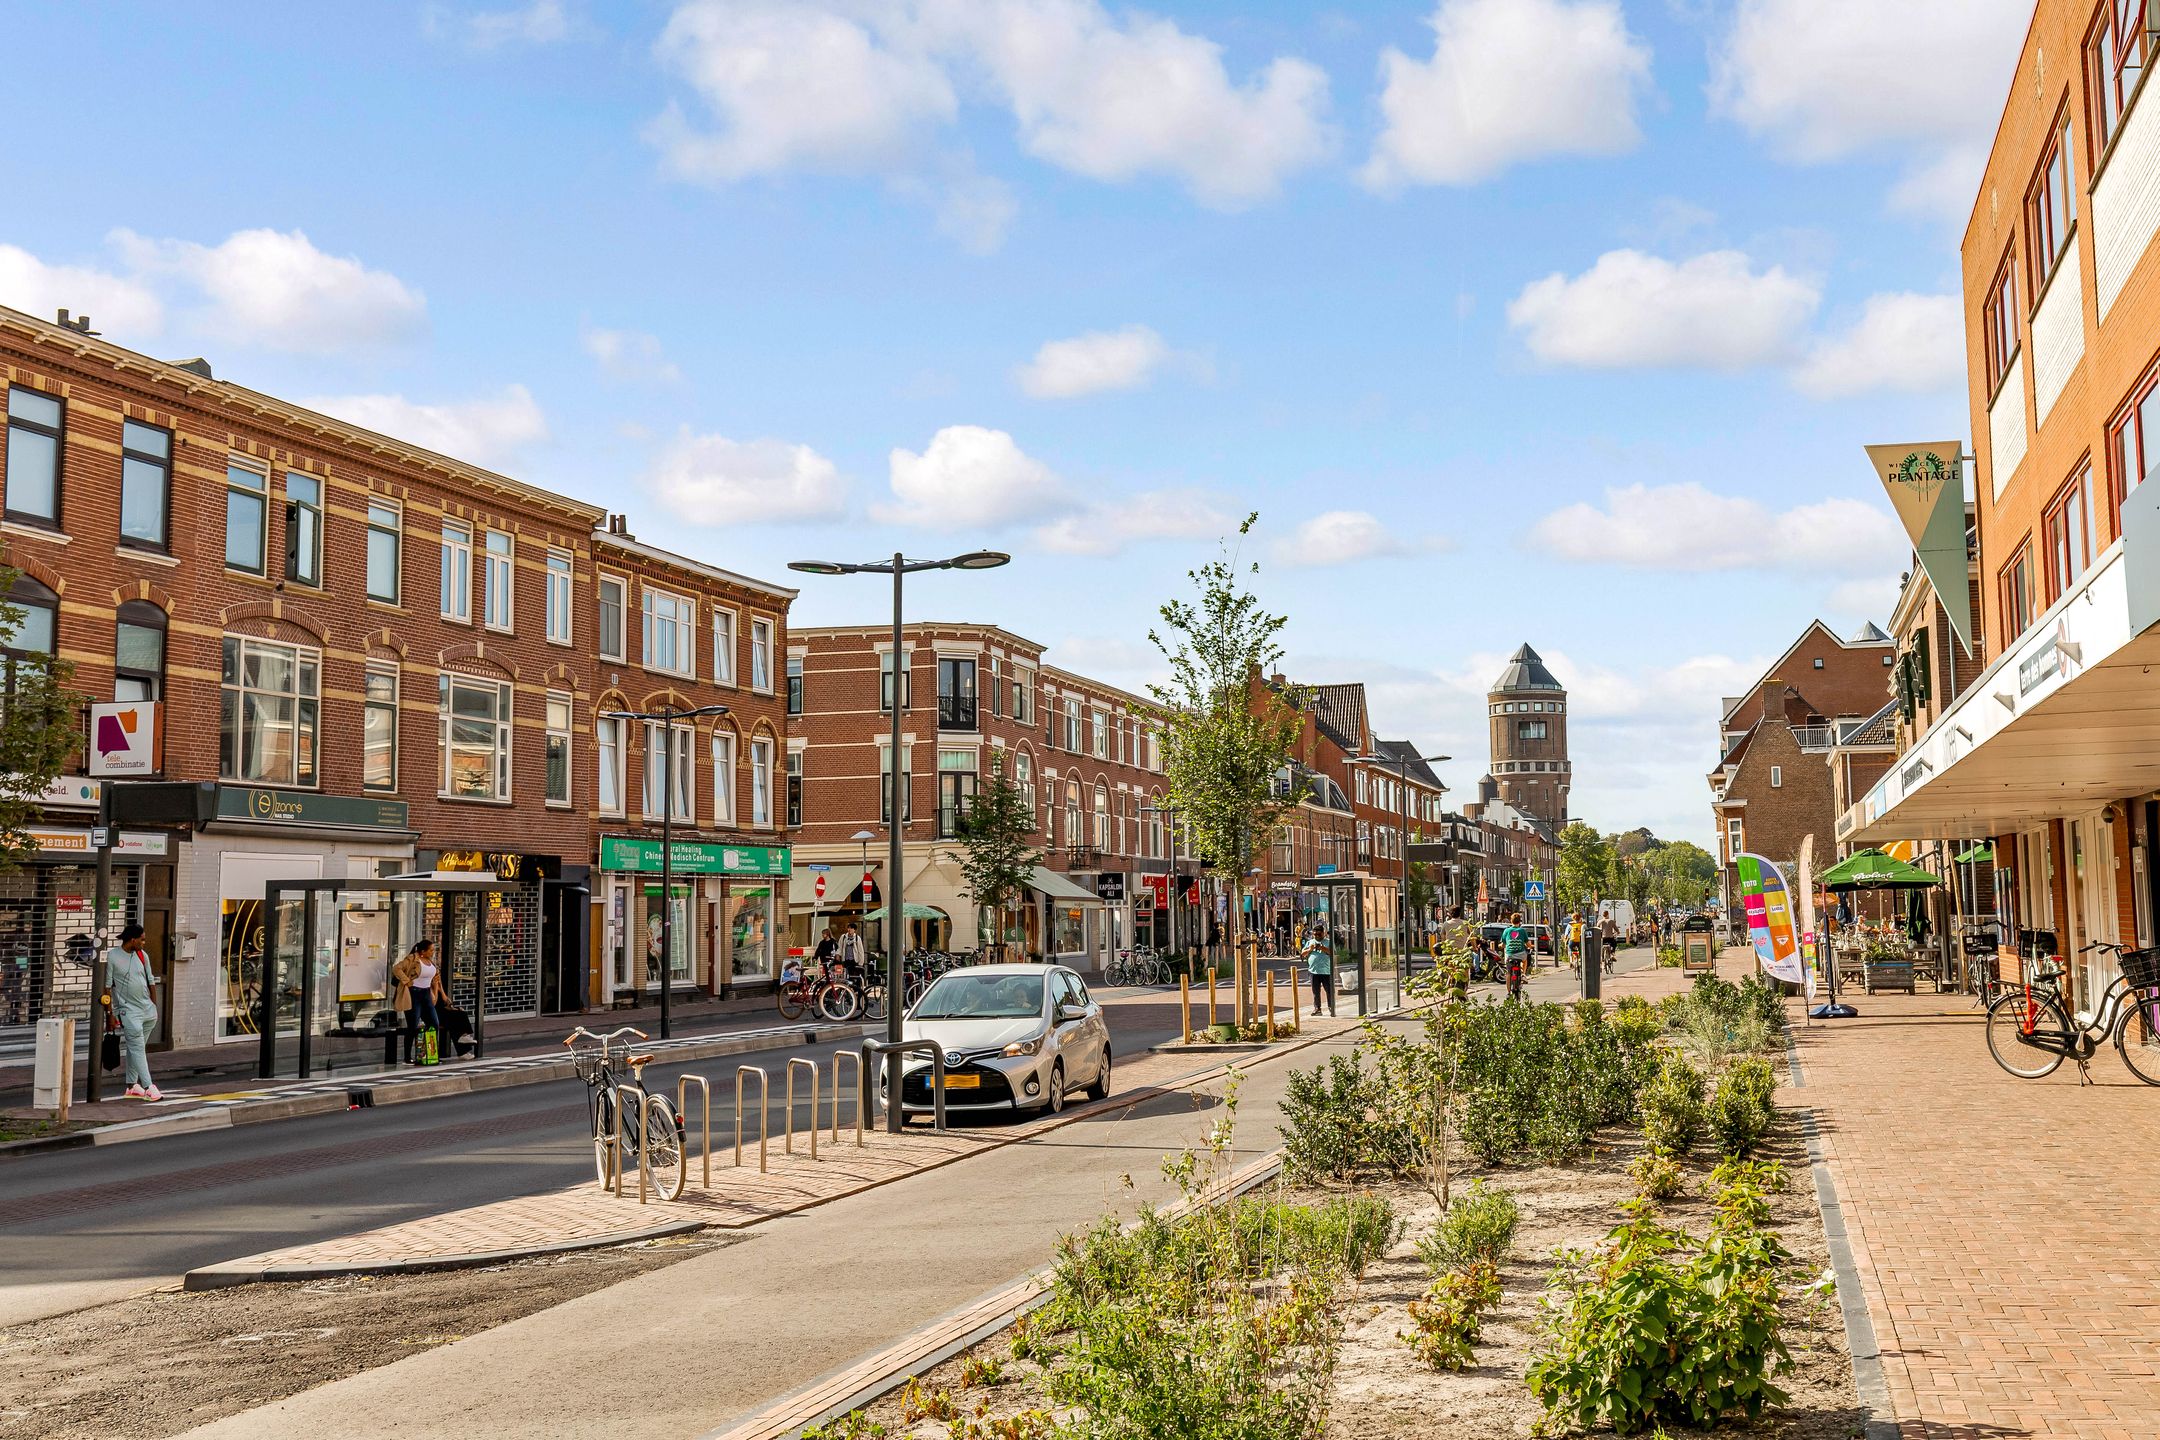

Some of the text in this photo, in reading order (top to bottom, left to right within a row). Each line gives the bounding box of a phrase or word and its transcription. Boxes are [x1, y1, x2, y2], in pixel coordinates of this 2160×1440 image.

[1888, 470, 1959, 483] PLANTAGE
[106, 754, 121, 762] tele
[105, 760, 146, 769] combinatie
[42, 786, 69, 796] egeld.
[659, 843, 702, 855] Nral Healing
[644, 850, 664, 860] Chine
[692, 853, 715, 862] Centrum
[1098, 883, 1123, 891] KAPSALON
